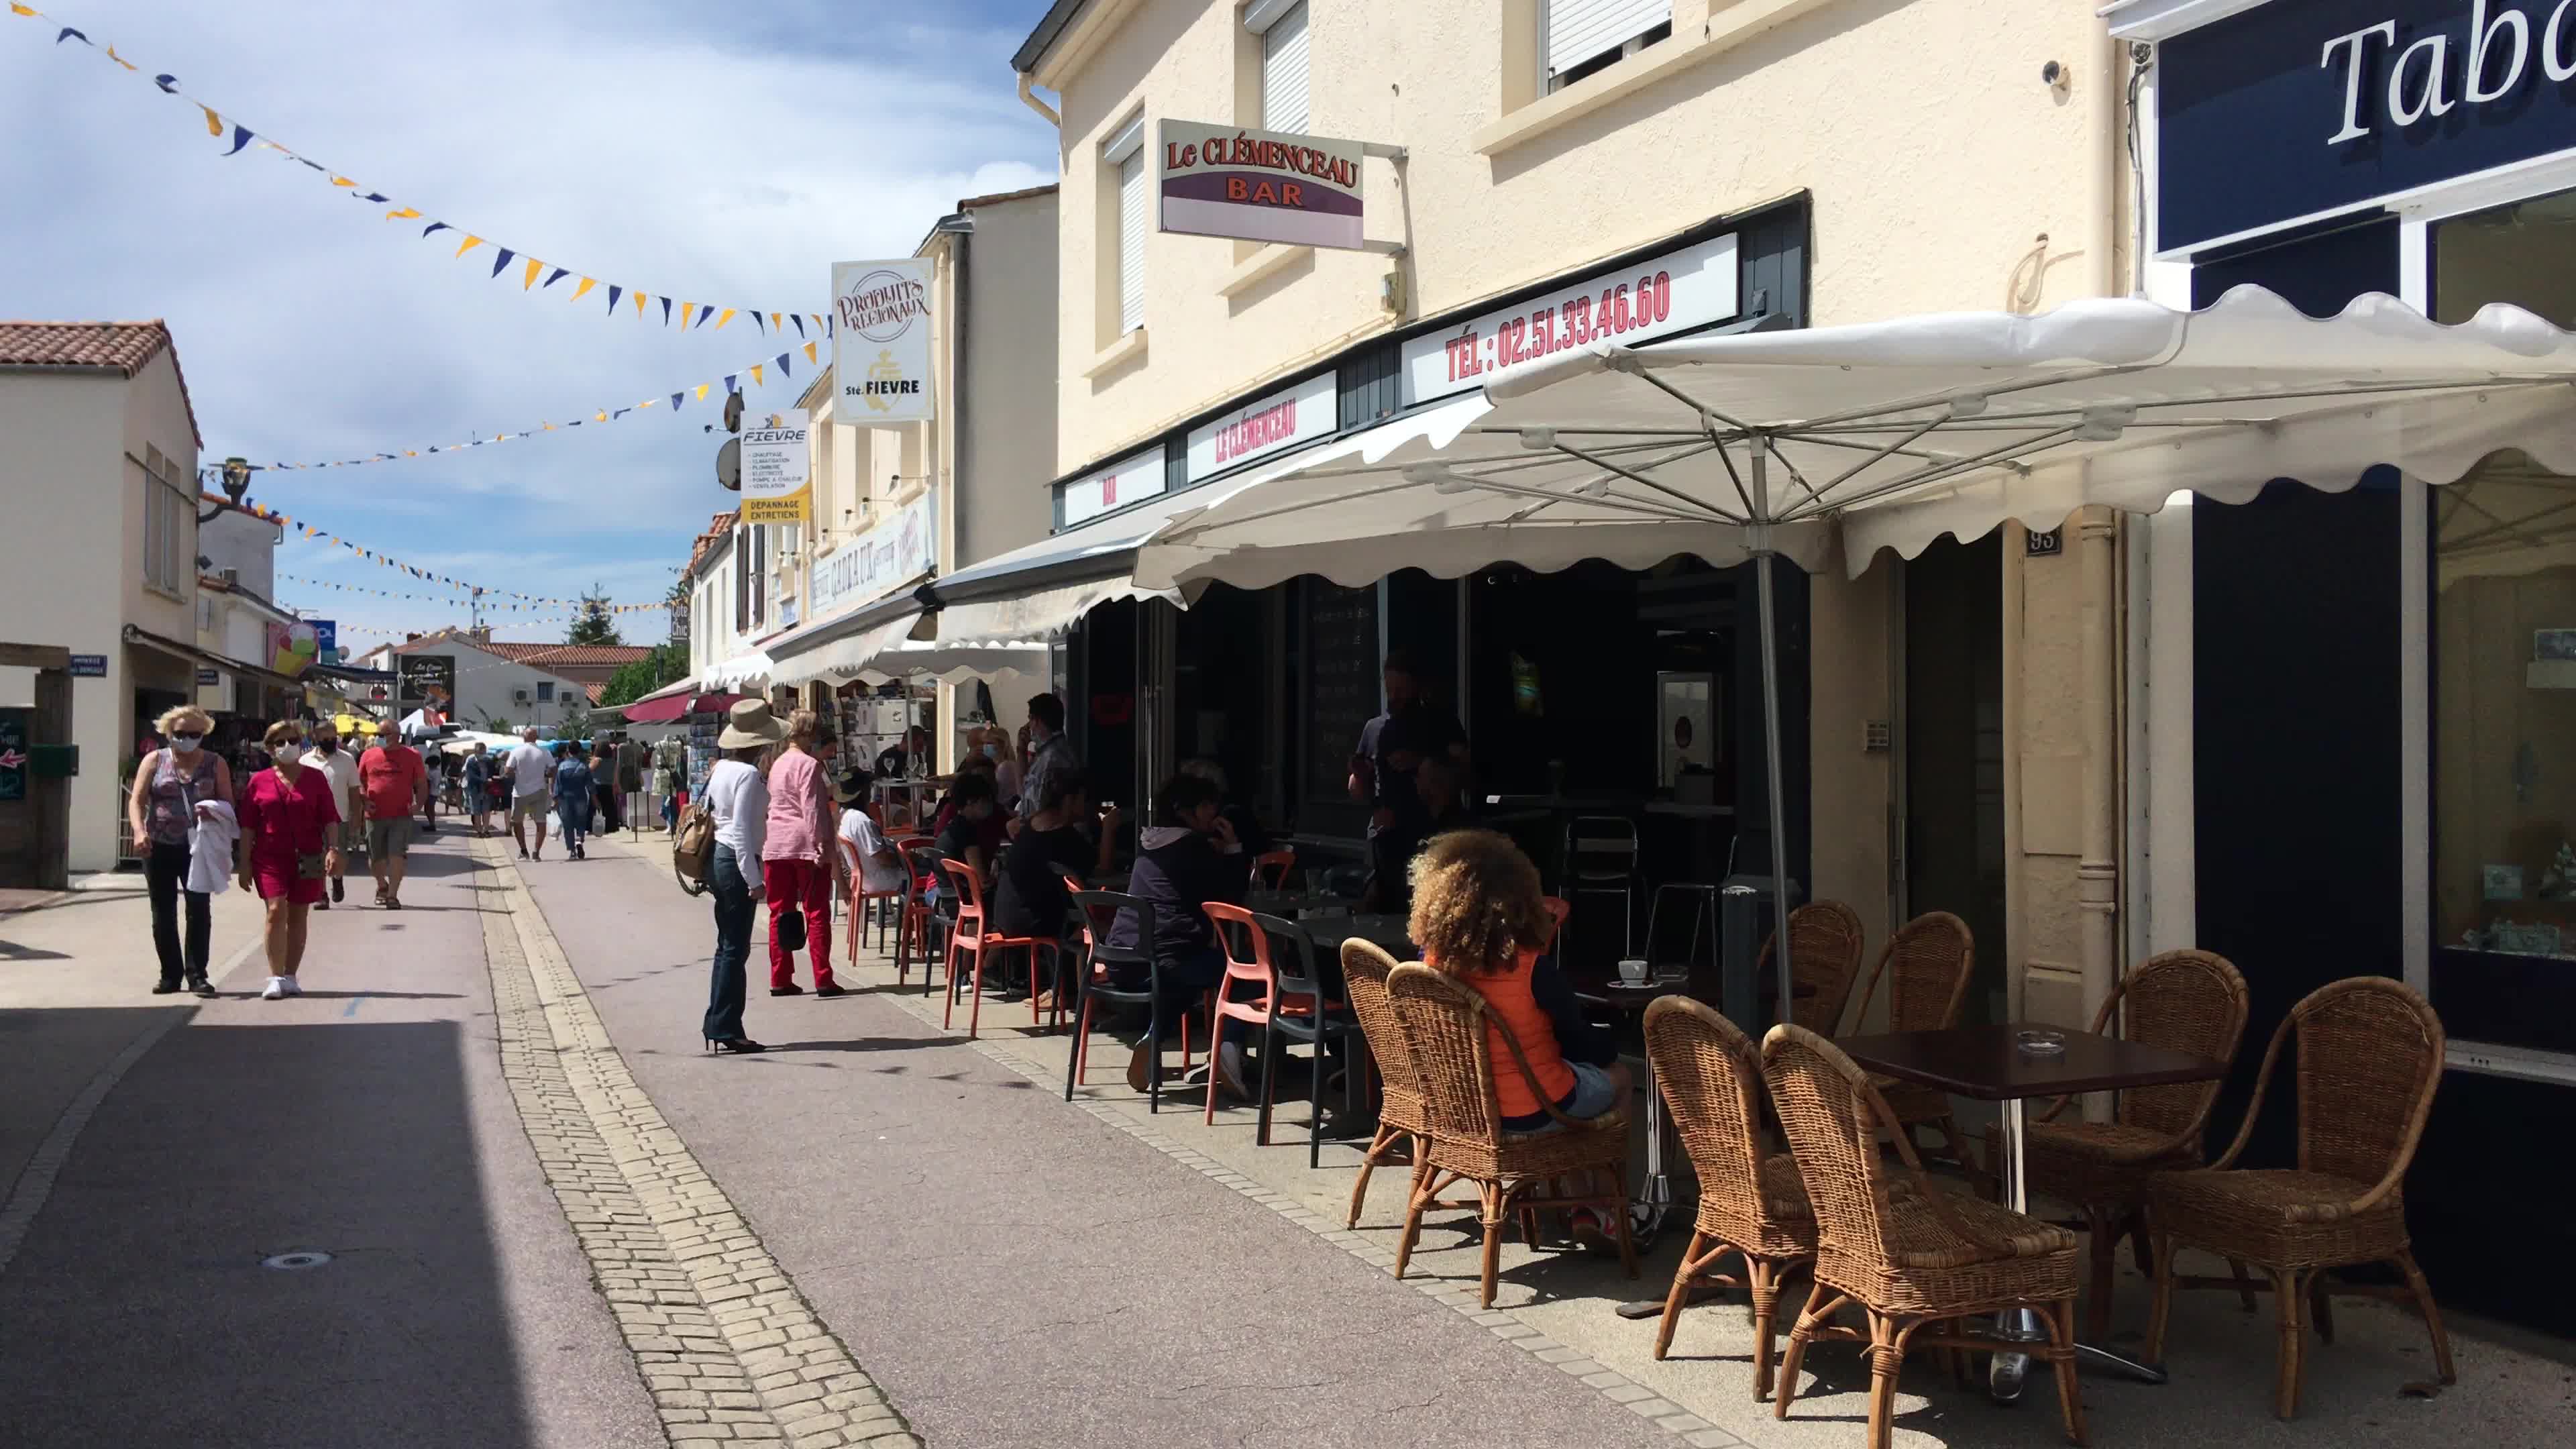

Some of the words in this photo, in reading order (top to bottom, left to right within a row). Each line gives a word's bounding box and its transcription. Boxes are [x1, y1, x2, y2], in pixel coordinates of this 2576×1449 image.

[1167, 141, 1197, 171] Le
[1203, 131, 1359, 189] CLÉMENCEAU
[1226, 176, 1306, 208] BAR
[837, 279, 923, 328] PRODUITS
[1497, 270, 1670, 368] 02.51.33.46.60
[866, 380, 920, 394] FIEVRE
[743, 430, 806, 442] FIEVRE
[1216, 427, 1227, 463] LE
[1229, 397, 1296, 459] CLÉMENCEAU
[751, 511, 800, 520] ENTRETIENS
[672, 621, 688, 637] Chic
